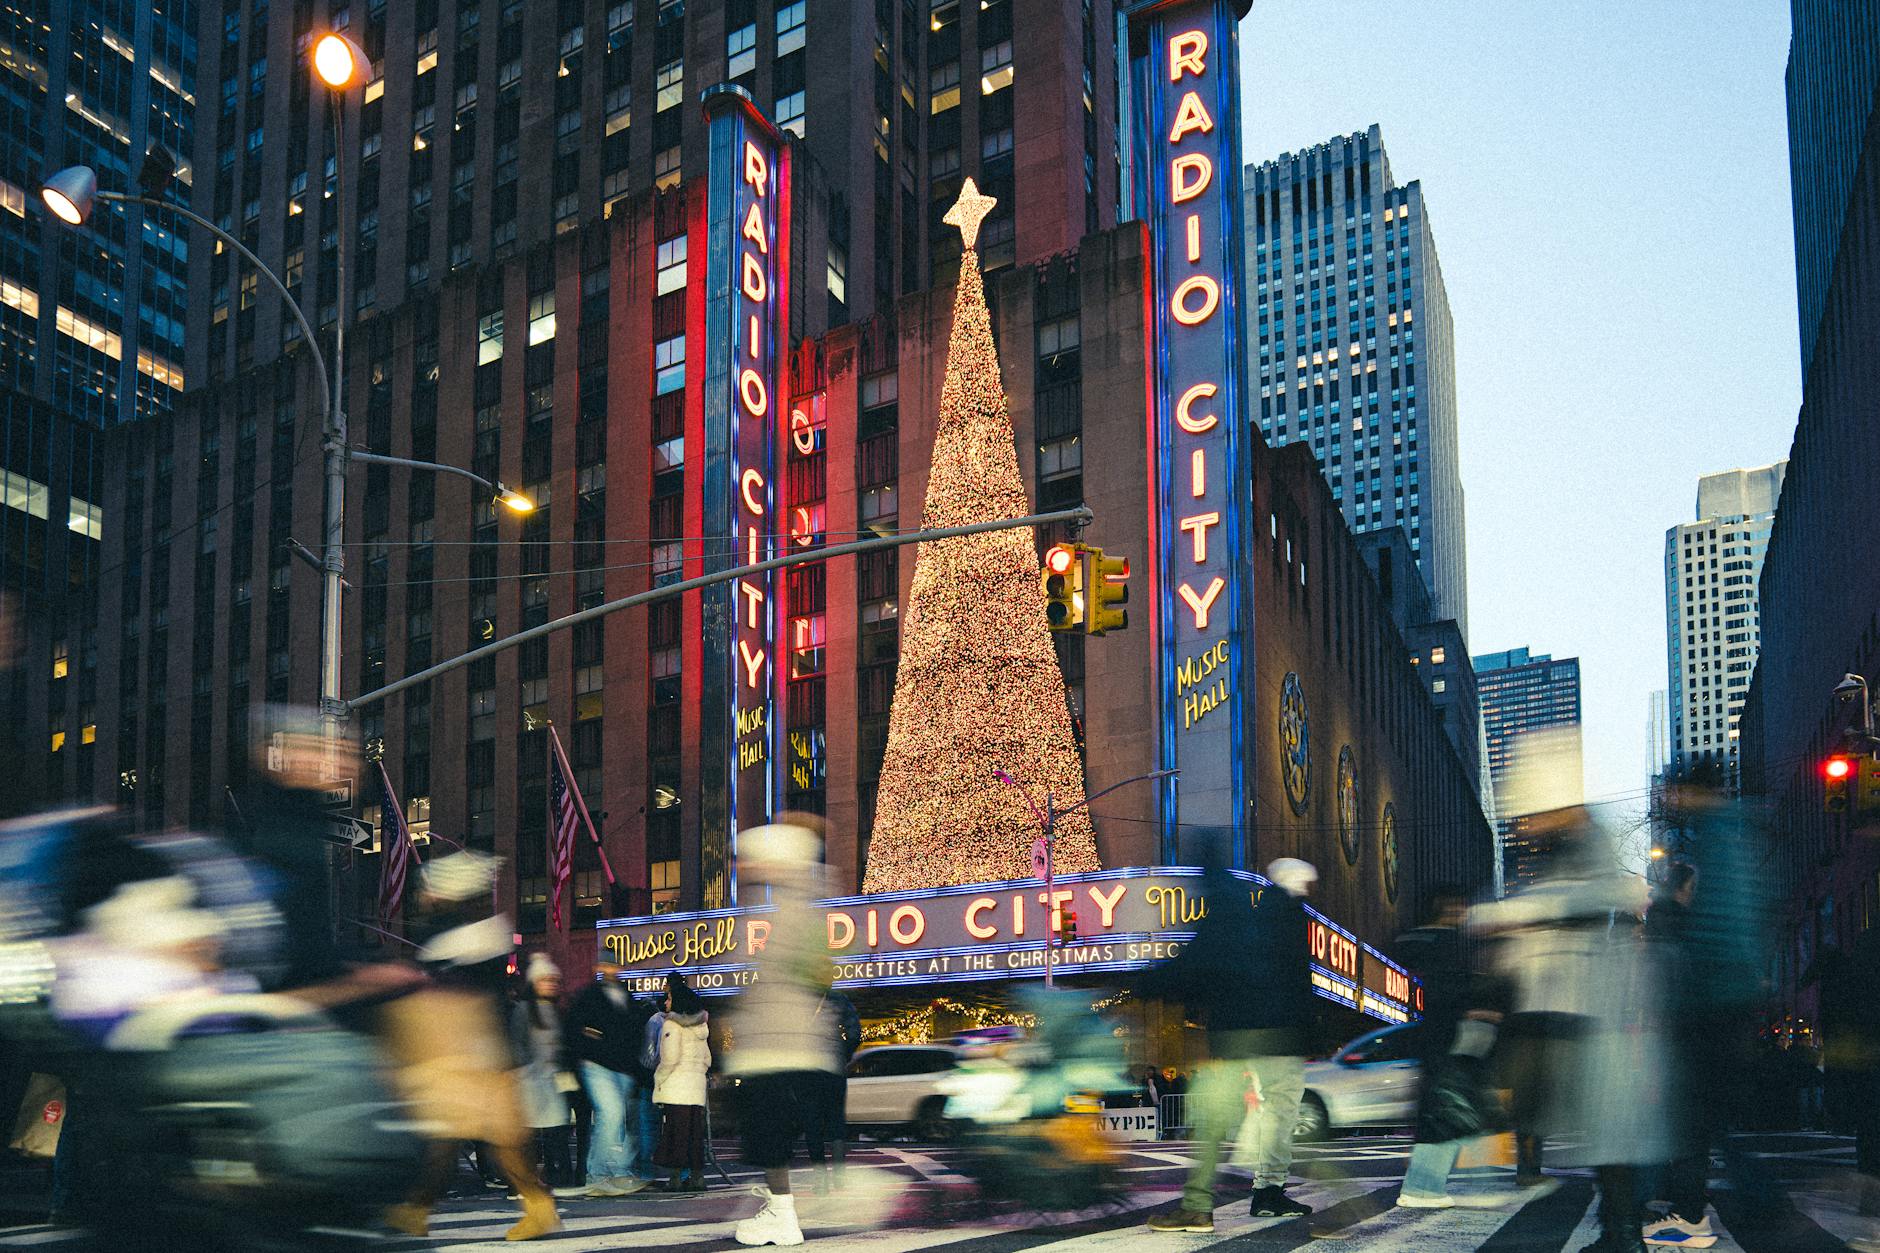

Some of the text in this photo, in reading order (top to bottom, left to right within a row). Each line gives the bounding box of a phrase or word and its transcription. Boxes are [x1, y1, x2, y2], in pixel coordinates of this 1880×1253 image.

[1169, 30, 1225, 629] RADIO CITY
[739, 140, 768, 689] RADIO CITY
[1177, 639, 1229, 696] MUSIC
[737, 705, 765, 739] MUSIC
[1185, 678, 1229, 730] HALL
[740, 740, 764, 771] HALL
[326, 789, 345, 801] WAY
[338, 824, 360, 839] WAY
[605, 933, 676, 966] Music
[672, 916, 737, 966] Hall
[747, 904, 926, 956] RDIO
[965, 884, 1127, 938] CITY
[1145, 886, 1209, 928] Mu
[697, 973, 723, 988] 100
[733, 971, 759, 985] YEA
[832, 959, 917, 980] OCKETTES
[928, 957, 950, 973] AT
[963, 953, 995, 971] THE
[1007, 945, 1114, 968] CHRISTMAS
[1128, 943, 1182, 960] SPEC
[1308, 921, 1357, 976] IO CITY
[1385, 967, 1409, 1003] RADIO
[1096, 1115, 1146, 1131] NYPD
